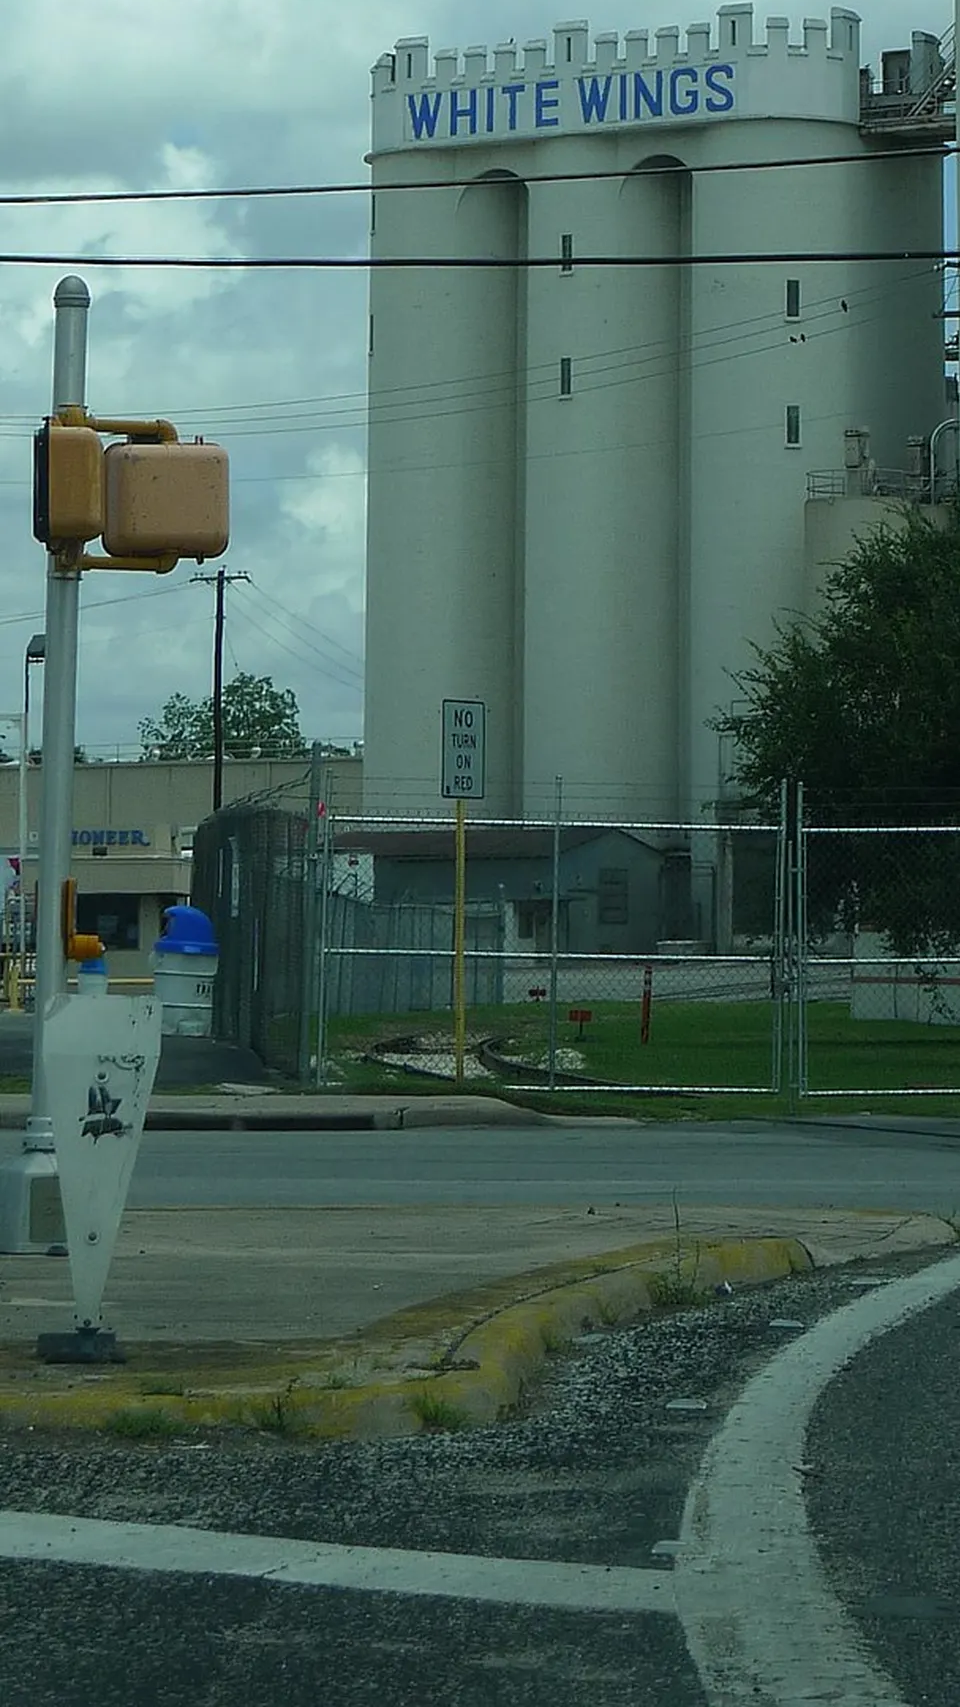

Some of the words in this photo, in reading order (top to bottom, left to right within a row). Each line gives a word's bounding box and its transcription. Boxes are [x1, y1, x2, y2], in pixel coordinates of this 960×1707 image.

[407, 80, 560, 139] WHITE
[578, 64, 734, 123] WINGS
[454, 709, 473, 728] NO
[452, 733, 477, 749] TURN
[456, 755, 471, 769] ON
[454, 776, 473, 791] RED
[71, 830, 151, 847] IONEER
